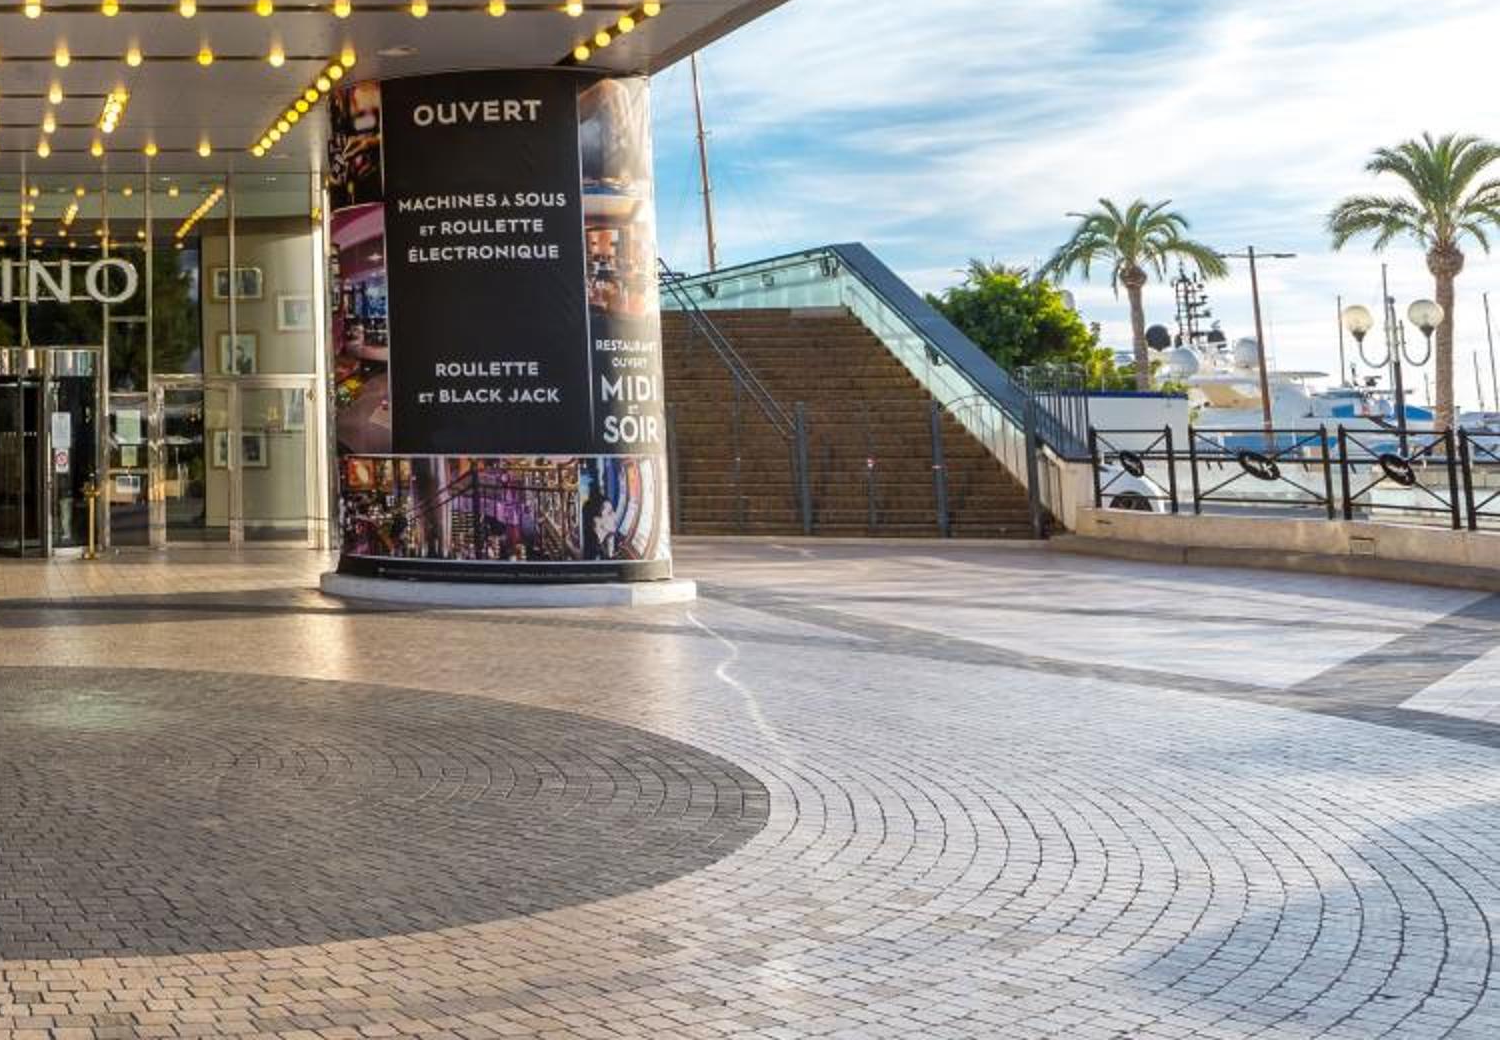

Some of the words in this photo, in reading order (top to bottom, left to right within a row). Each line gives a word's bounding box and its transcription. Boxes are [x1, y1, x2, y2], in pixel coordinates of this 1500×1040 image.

[413, 99, 542, 127] OUVERT
[398, 193, 497, 213] MACHINES
[514, 192, 567, 208] SOUS
[419, 225, 436, 237] ET
[440, 218, 544, 235] ROULETTE
[408, 244, 560, 263] ÉLECTRONIQUE
[435, 361, 540, 378] ROULETTE
[418, 392, 435, 403] ET
[439, 388, 503, 403] BLACK
[508, 387, 561, 403] JACK
[601, 375, 658, 401] MIDI
[603, 415, 660, 444] SOIR
